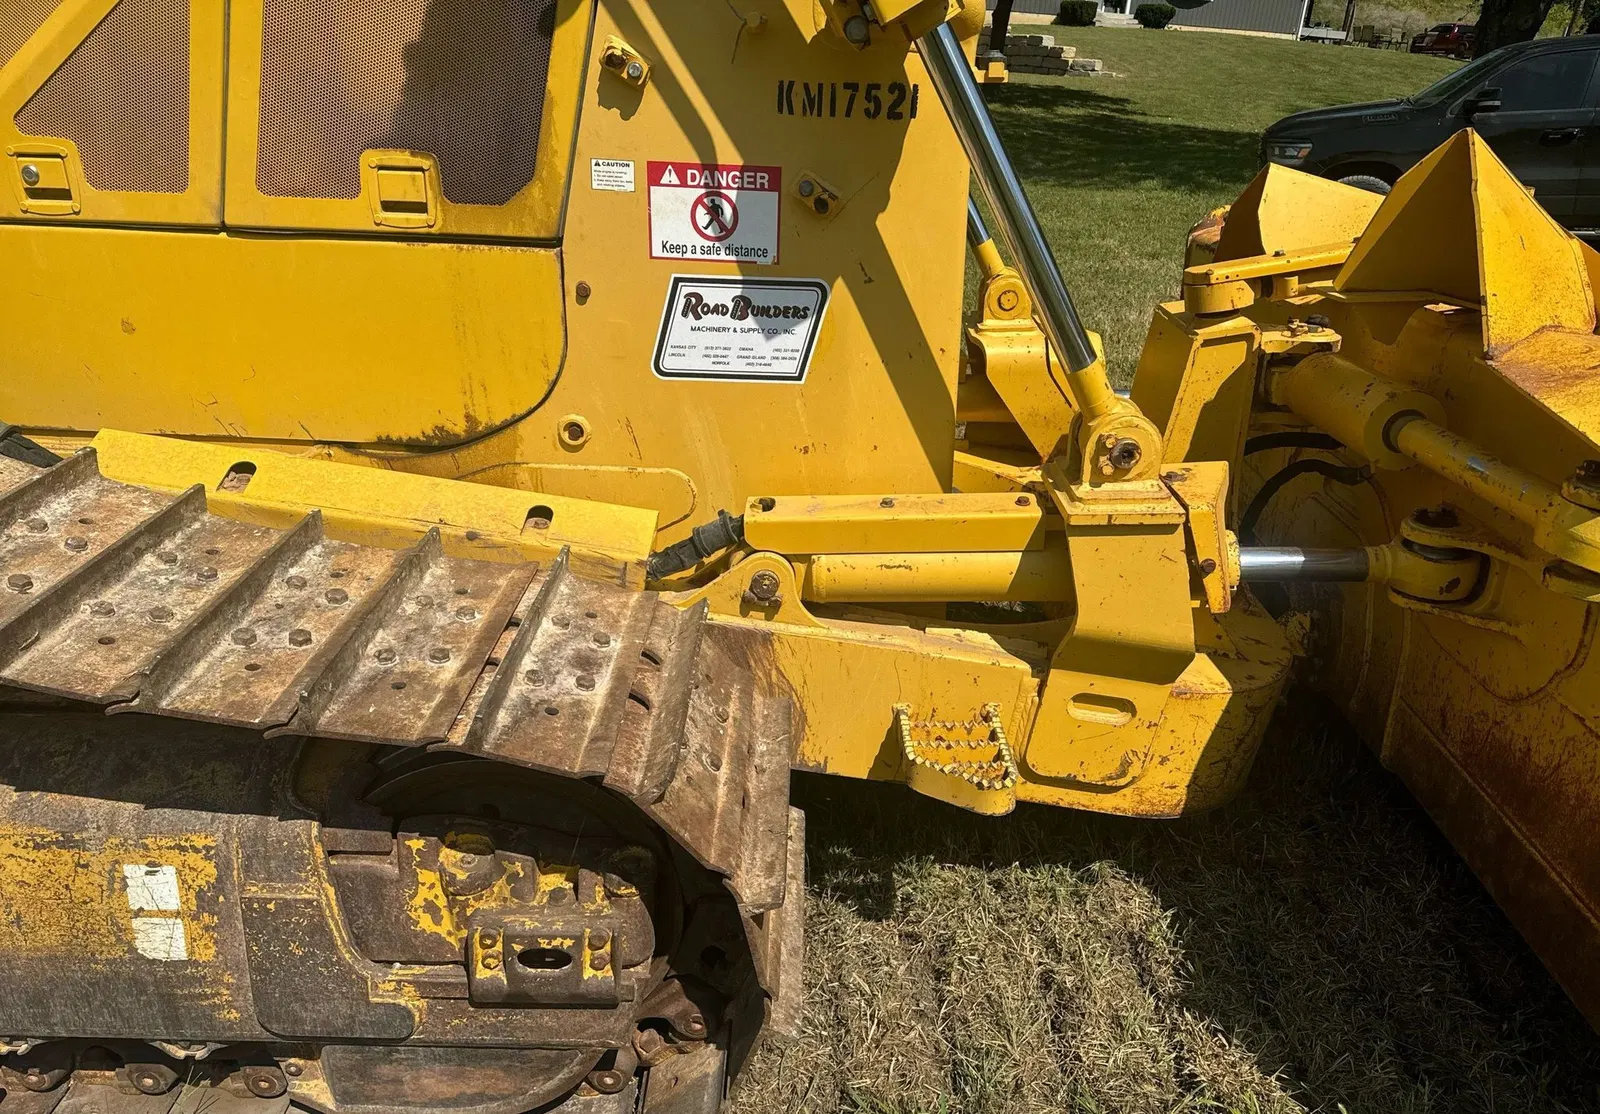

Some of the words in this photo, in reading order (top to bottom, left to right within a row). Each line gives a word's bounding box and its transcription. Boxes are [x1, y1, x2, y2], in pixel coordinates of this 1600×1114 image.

[686, 169, 770, 189] DANGER
[661, 240, 688, 257] Keep
[691, 245, 697, 255] a
[699, 242, 721, 256] safe
[724, 244, 768, 258] distance
[681, 291, 730, 321] ROAD
[730, 294, 811, 321] BUILDERS
[690, 325, 731, 334] MACHINERY
[739, 327, 766, 335] SUPPLY
